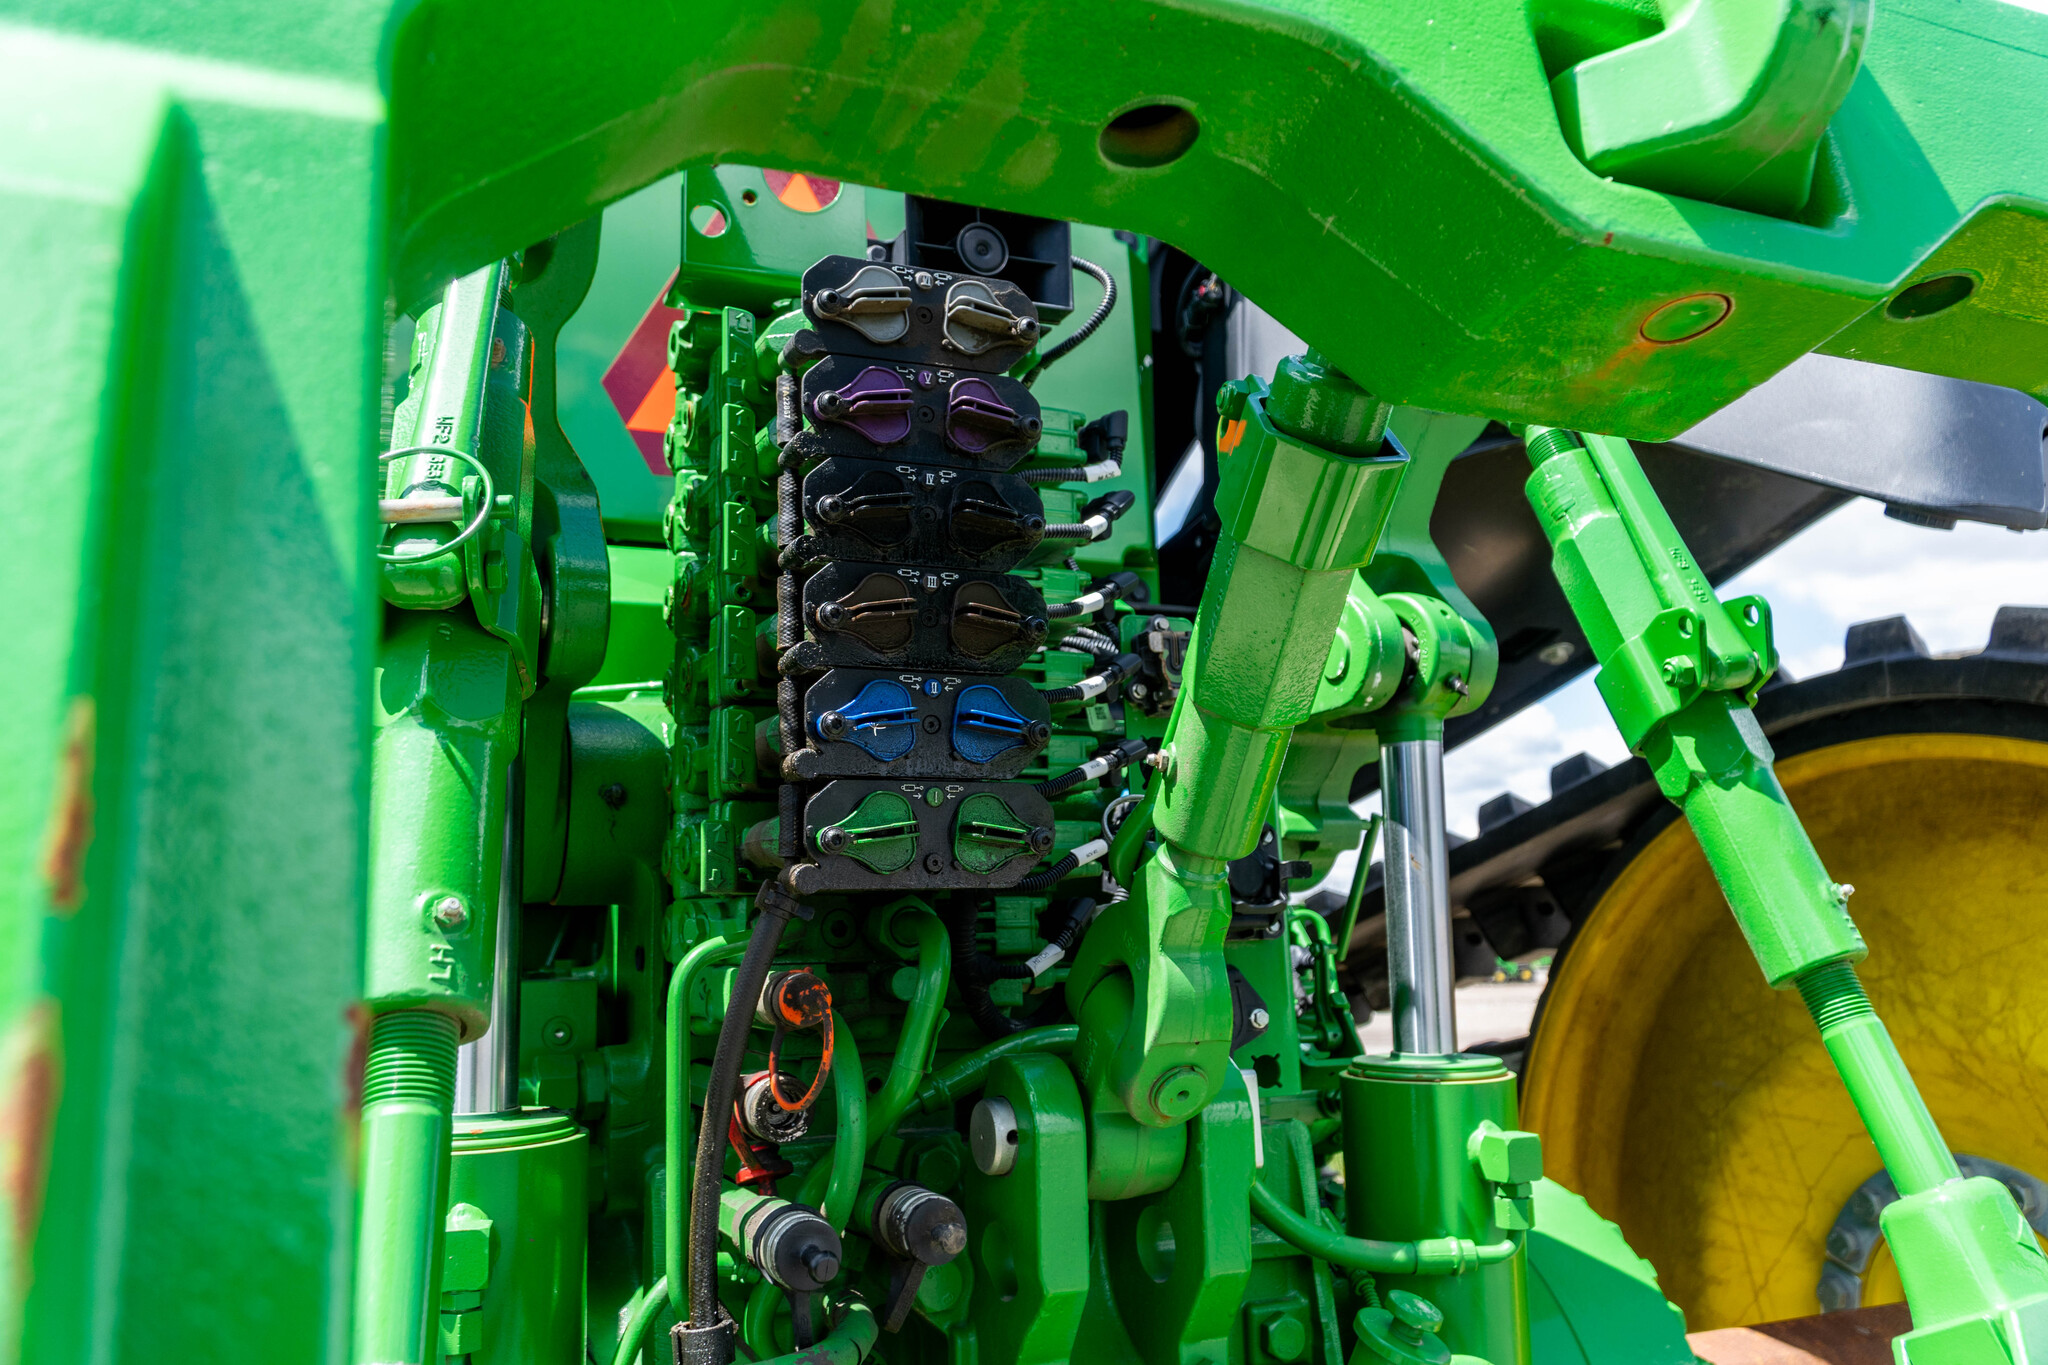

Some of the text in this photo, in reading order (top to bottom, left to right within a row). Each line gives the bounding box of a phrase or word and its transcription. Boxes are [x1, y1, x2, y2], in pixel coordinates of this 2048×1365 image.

[924, 372, 933, 385] V
[926, 473, 935, 486] IV
[927, 575, 938, 589] III
[931, 681, 938, 694] II
[428, 944, 455, 979] LH
